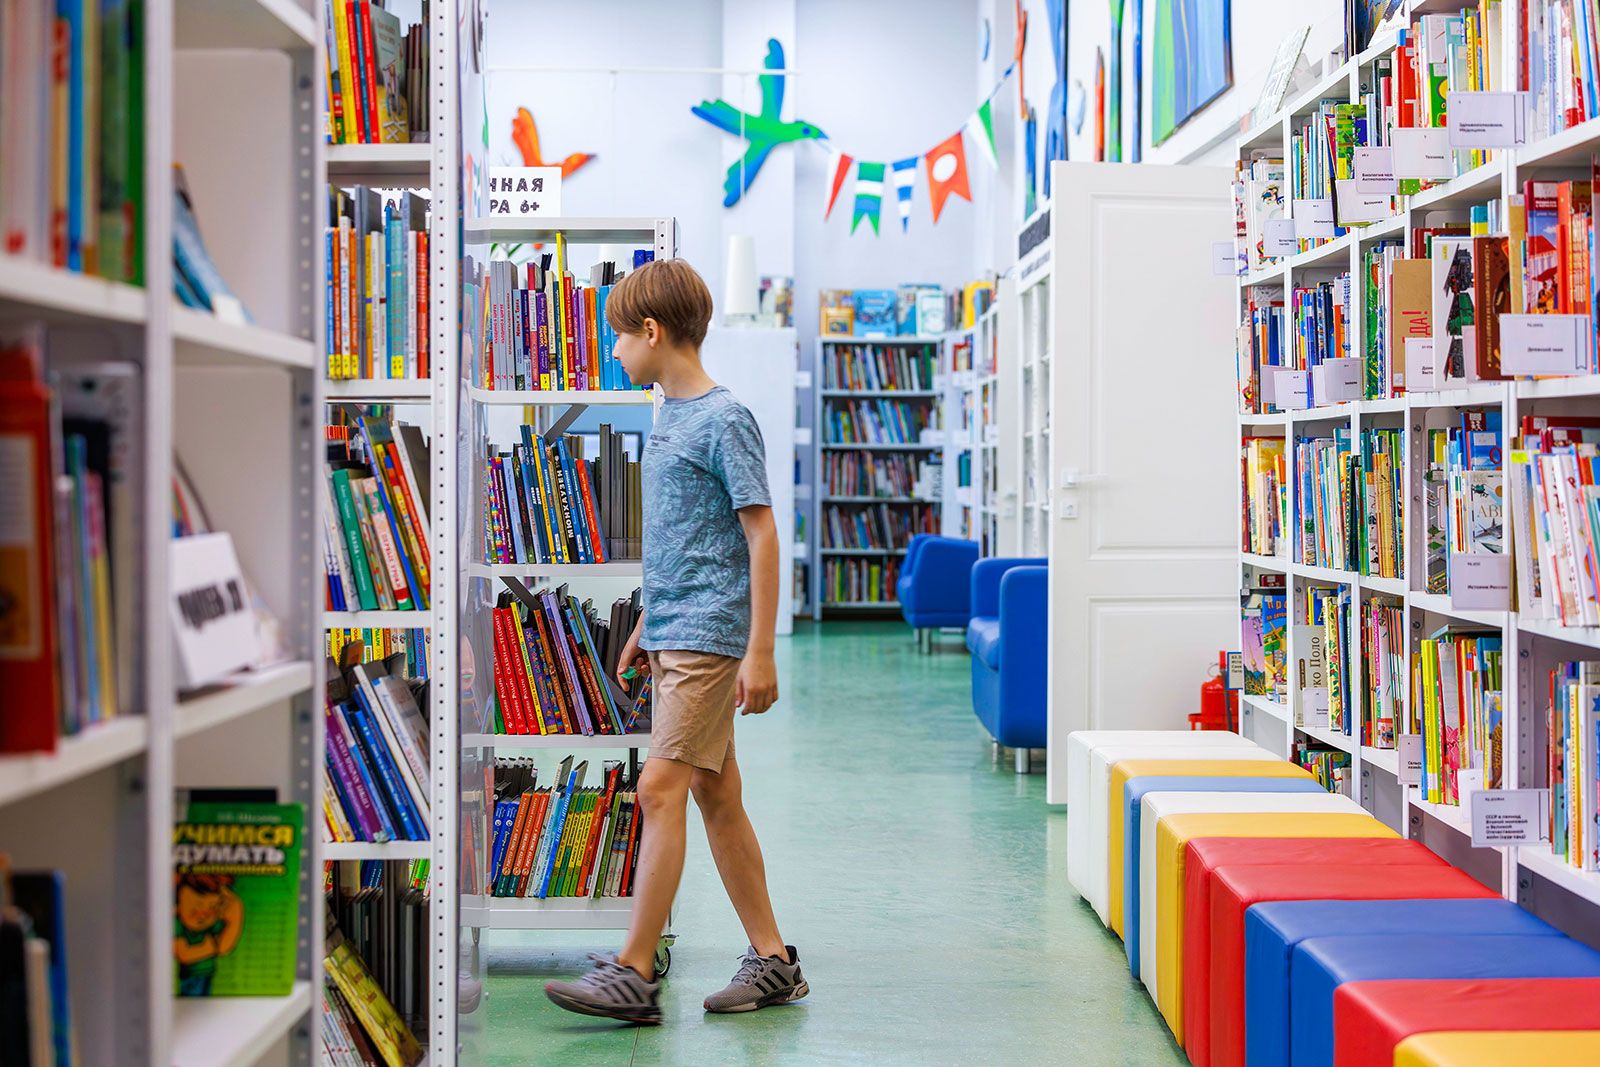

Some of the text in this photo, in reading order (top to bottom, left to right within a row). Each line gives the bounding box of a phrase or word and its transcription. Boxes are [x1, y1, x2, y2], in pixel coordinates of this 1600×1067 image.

[520, 199, 540, 213] 6+
[556, 469, 574, 538] МЮНХАУЗЕН
[173, 824, 294, 847] УЧИМСЯ
[172, 845, 285, 866] ДУМАТЬ
